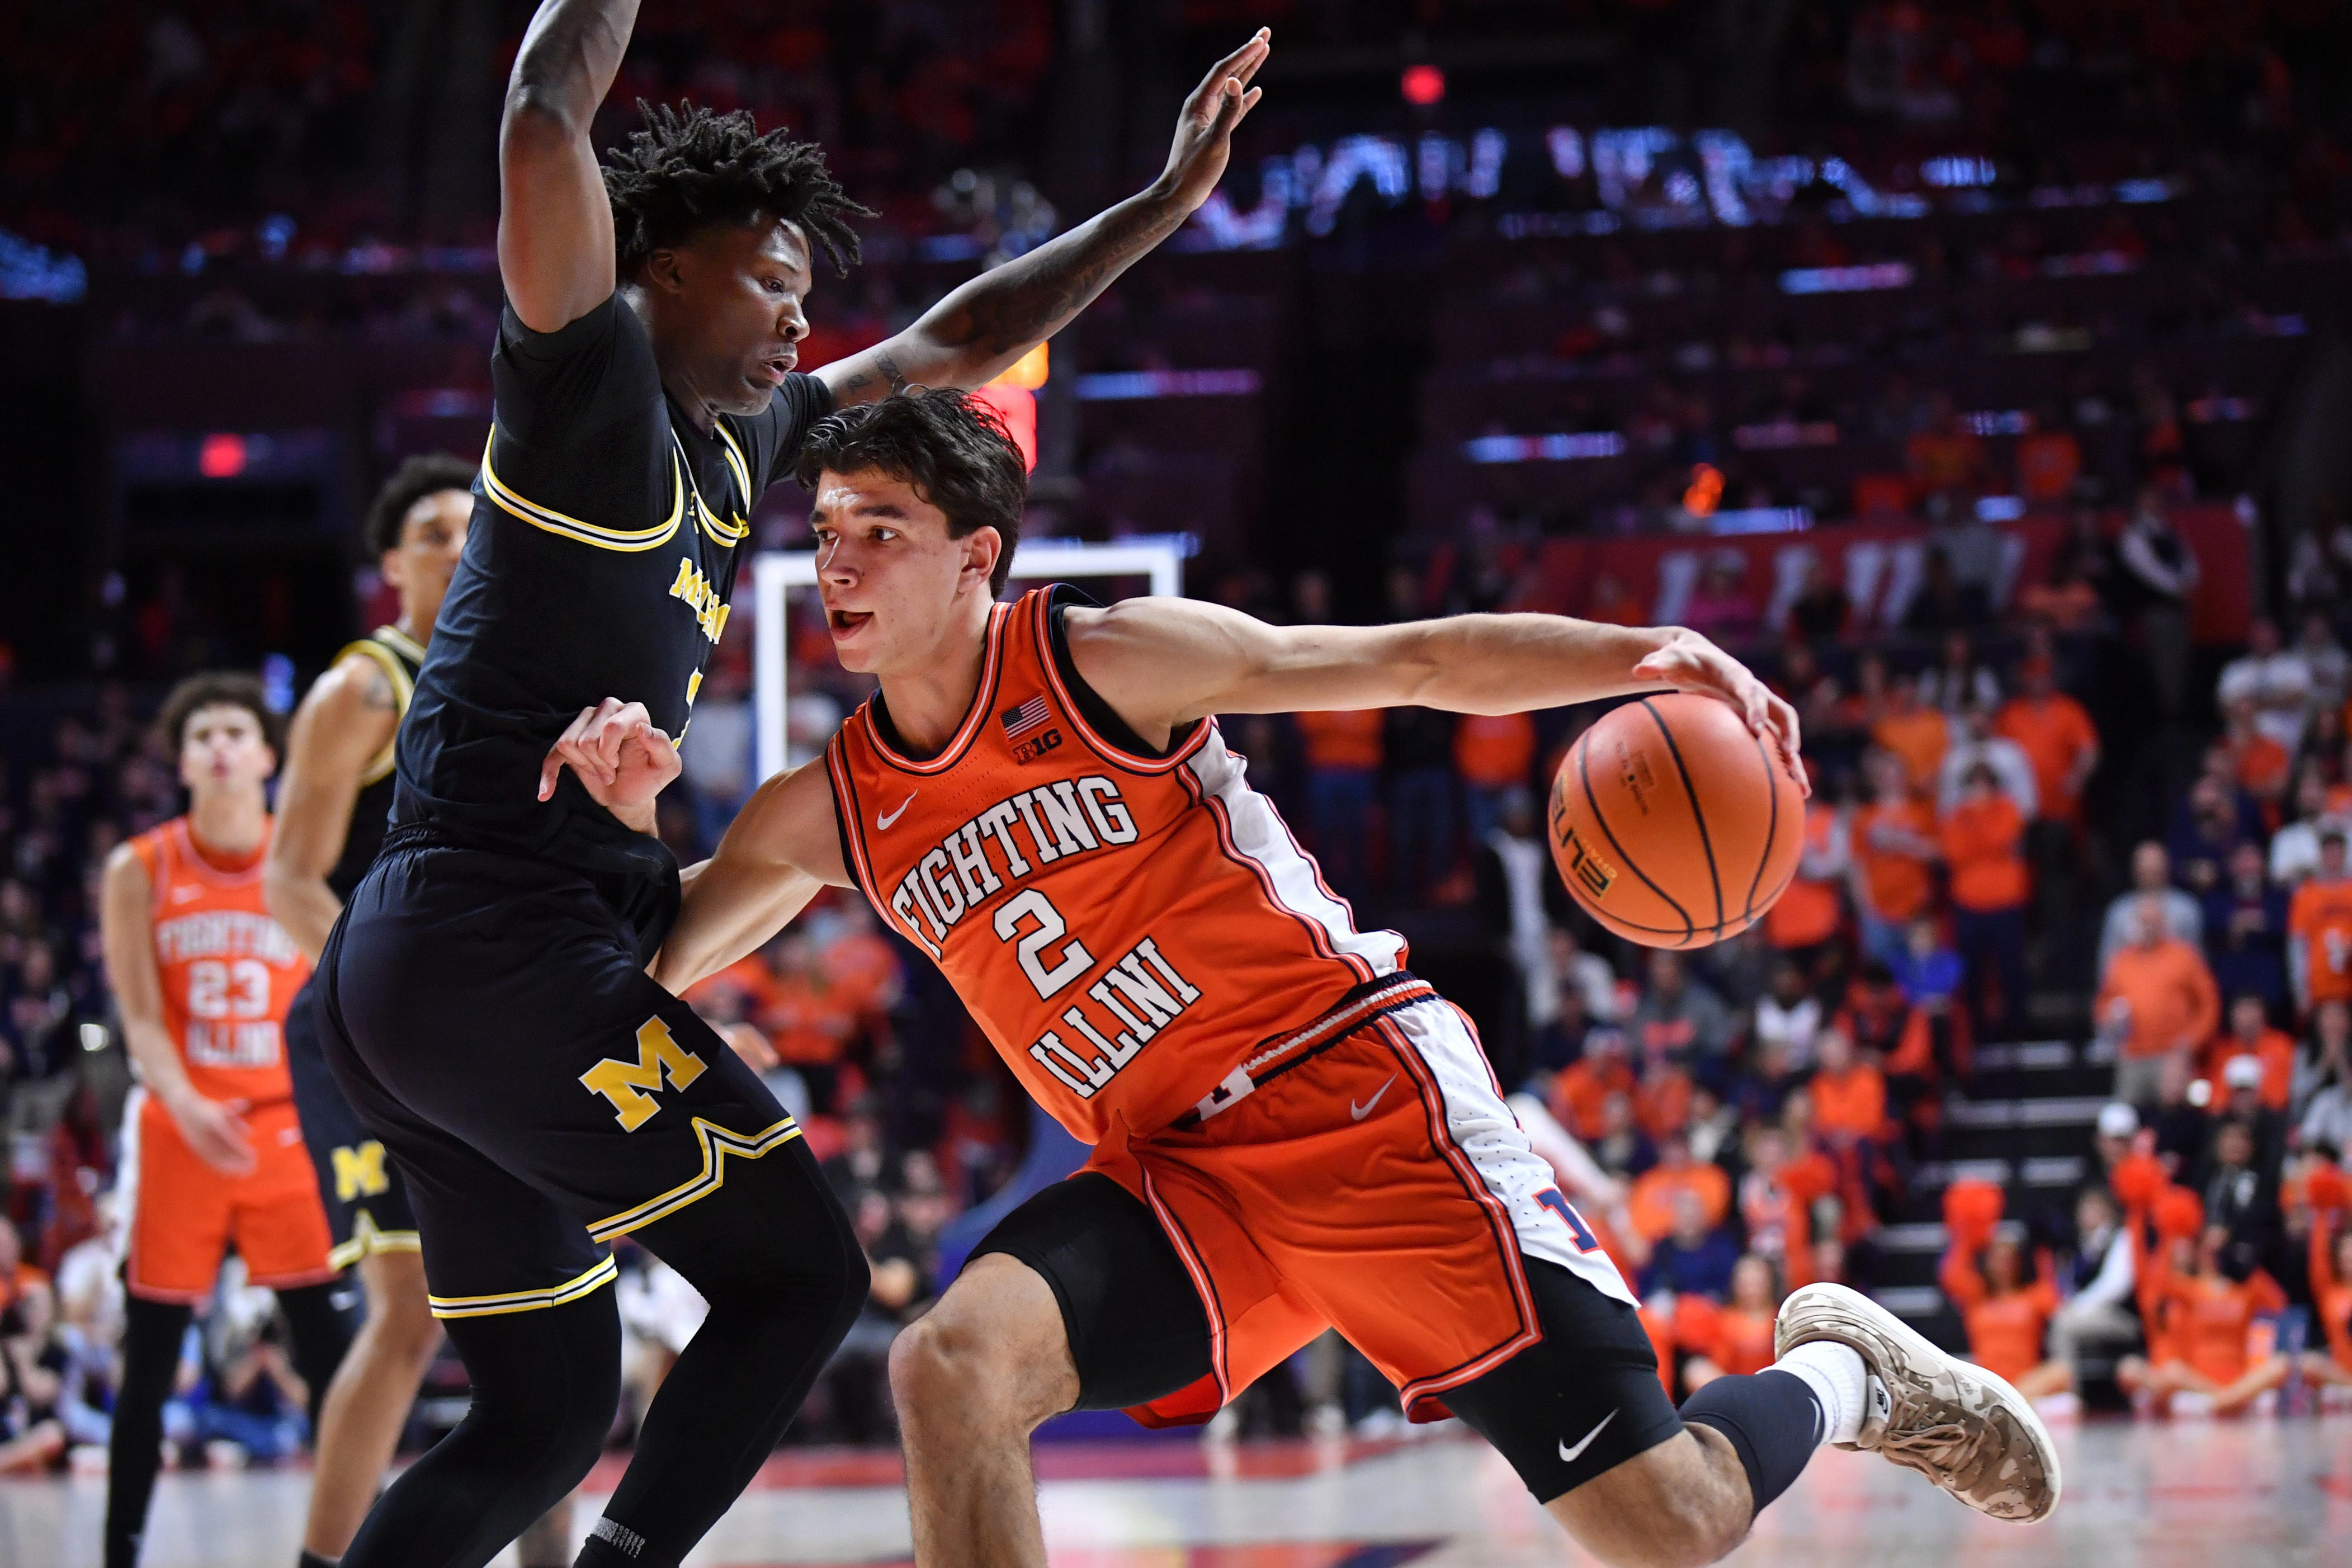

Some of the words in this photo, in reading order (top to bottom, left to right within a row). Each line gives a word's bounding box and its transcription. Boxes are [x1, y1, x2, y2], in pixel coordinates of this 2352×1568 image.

[892, 775, 1140, 962] FIGHTING
[187, 960, 271, 1019] 23
[993, 887, 1098, 1001] 2
[578, 1014, 709, 1133] M
[1028, 936, 1203, 1099] ILLINI
[332, 1140, 389, 1201] M
